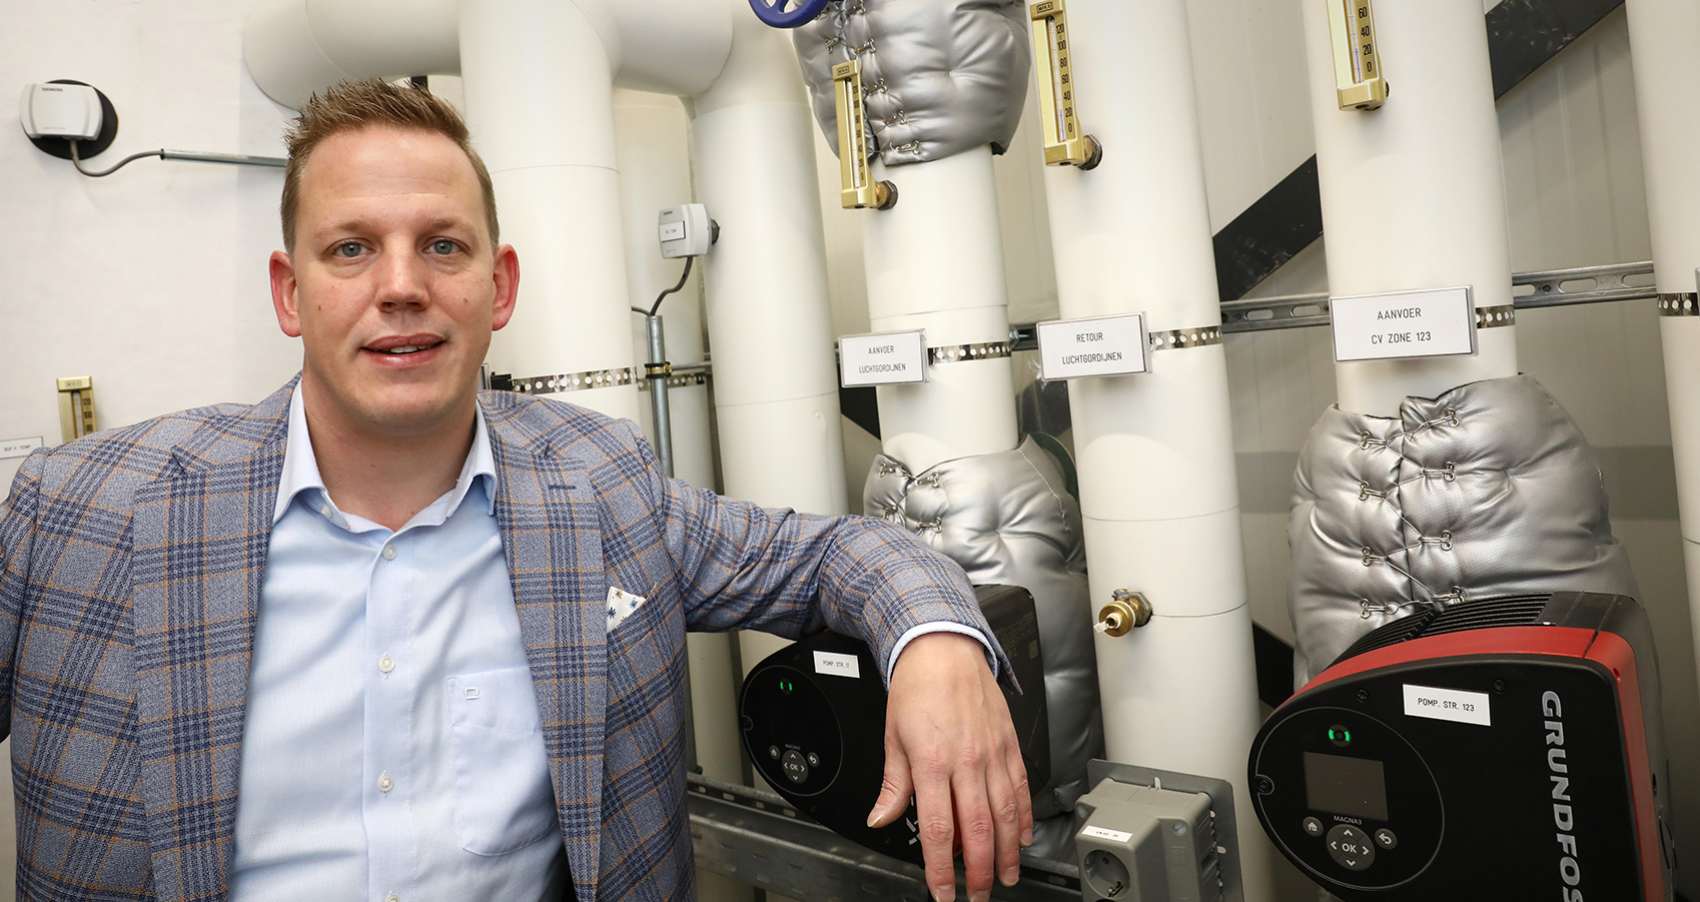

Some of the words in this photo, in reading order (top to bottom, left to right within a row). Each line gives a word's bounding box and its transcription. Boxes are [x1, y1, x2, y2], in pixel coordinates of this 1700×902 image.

[1358, 7, 1368, 18] 60
[1360, 26, 1370, 37] 40
[1362, 44, 1372, 55] 20
[1366, 61, 1372, 72] 0
[1067, 122, 1073, 133] 0
[1376, 307, 1422, 321] AANVOER
[1076, 332, 1104, 344] RETOUR
[1371, 334, 1383, 345] CV
[1388, 332, 1412, 345] ZONE
[1416, 331, 1432, 342] 123
[868, 345, 895, 355] AANVOER
[1062, 352, 1123, 365] LUCHTGORDIJNEN
[1462, 703, 1475, 712] 123
[1333, 815, 1363, 825] MAGNA3
[1341, 843, 1357, 854] OK
